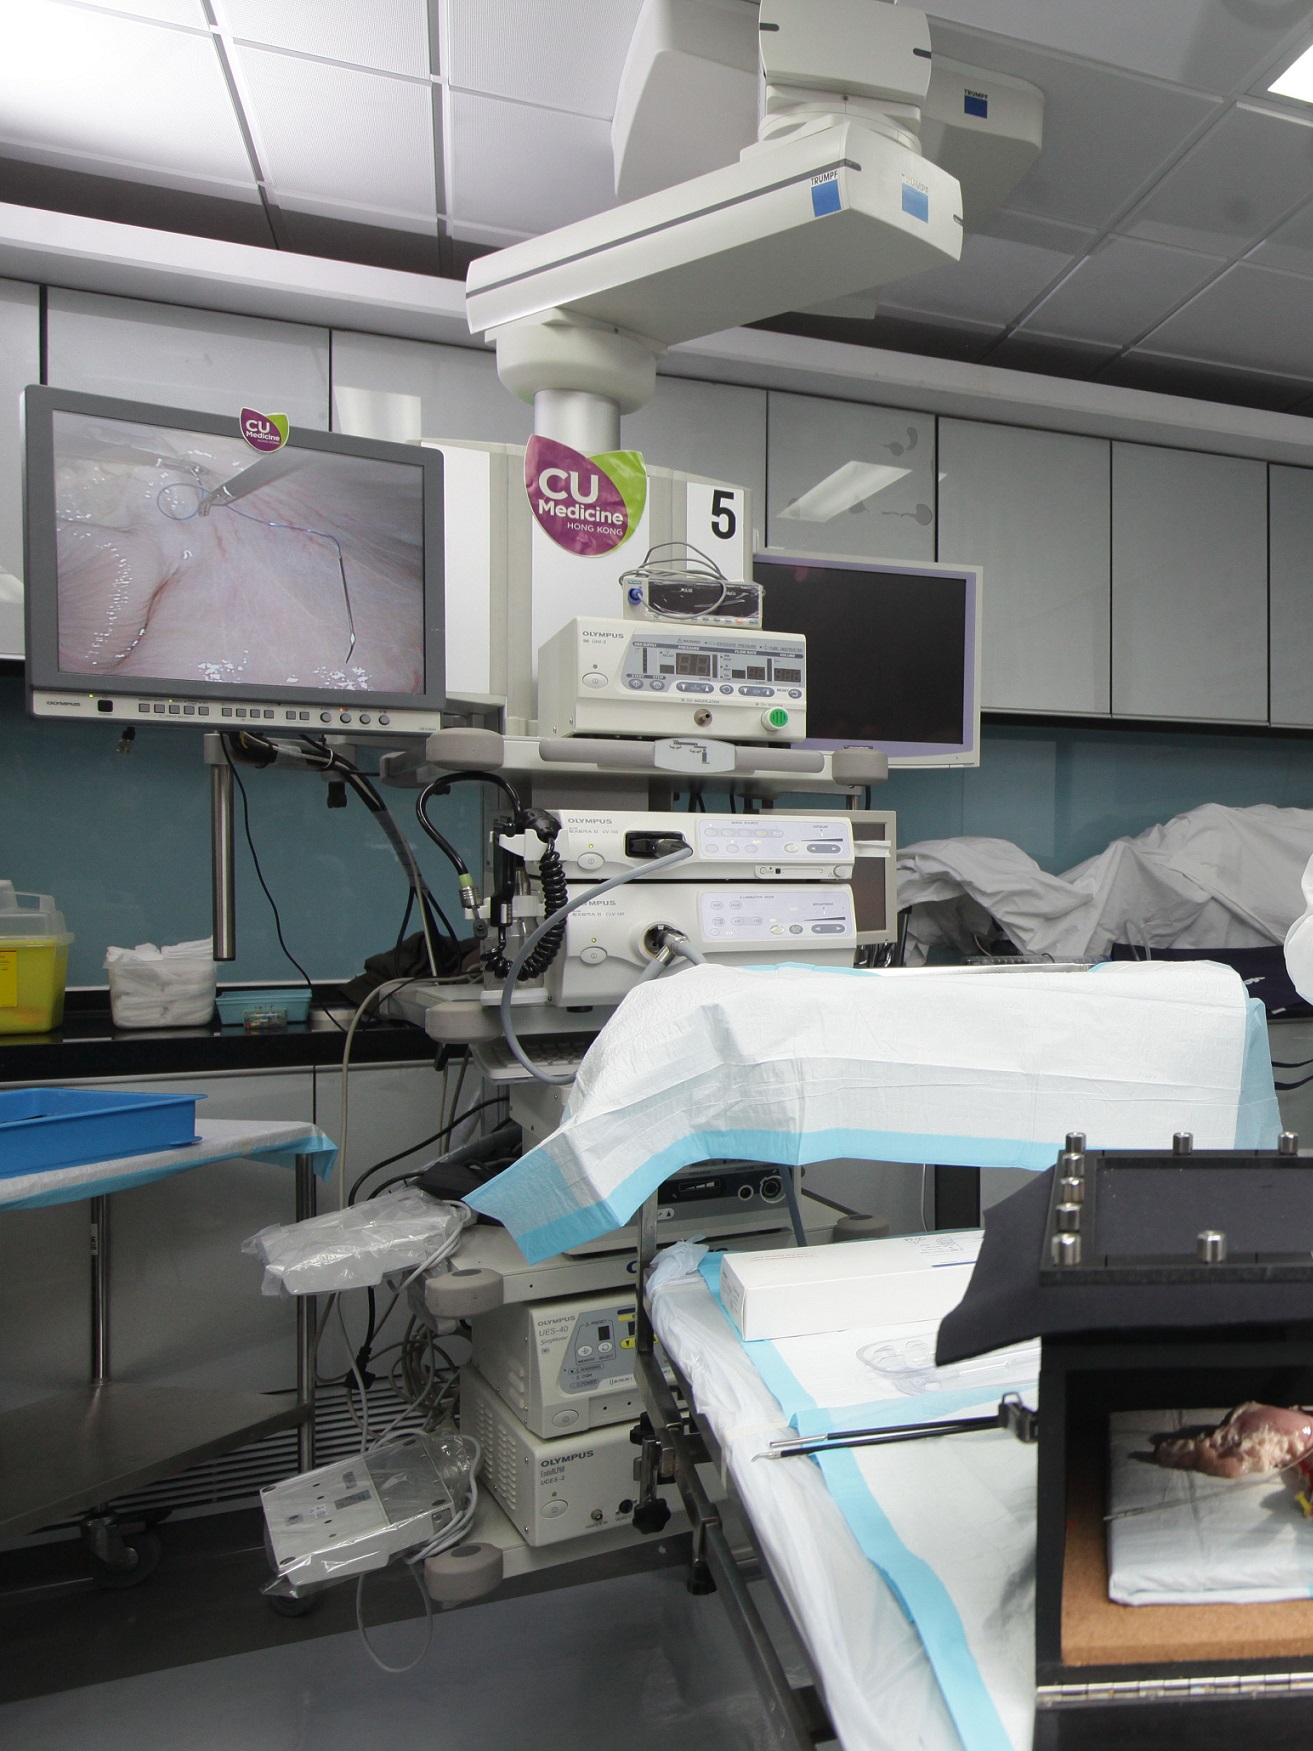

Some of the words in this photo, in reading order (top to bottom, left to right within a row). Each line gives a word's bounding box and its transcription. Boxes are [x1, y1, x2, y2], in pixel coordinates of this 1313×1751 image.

[811, 170, 838, 186] TRUMPF
[245, 419, 270, 433] CU
[246, 431, 280, 441] Medicine
[538, 468, 599, 504] CU
[538, 499, 624, 525] Medicine
[710, 489, 736, 540] 5
[567, 522, 595, 533] HONG
[596, 526, 623, 536] KONG
[582, 630, 624, 639] OLYMPUS
[537, 1315, 576, 1326] OLYMPUS
[538, 1326, 569, 1337] UES-40
[541, 1450, 594, 1468] OLYMPUS
[540, 1475, 566, 1486] UCES-2
